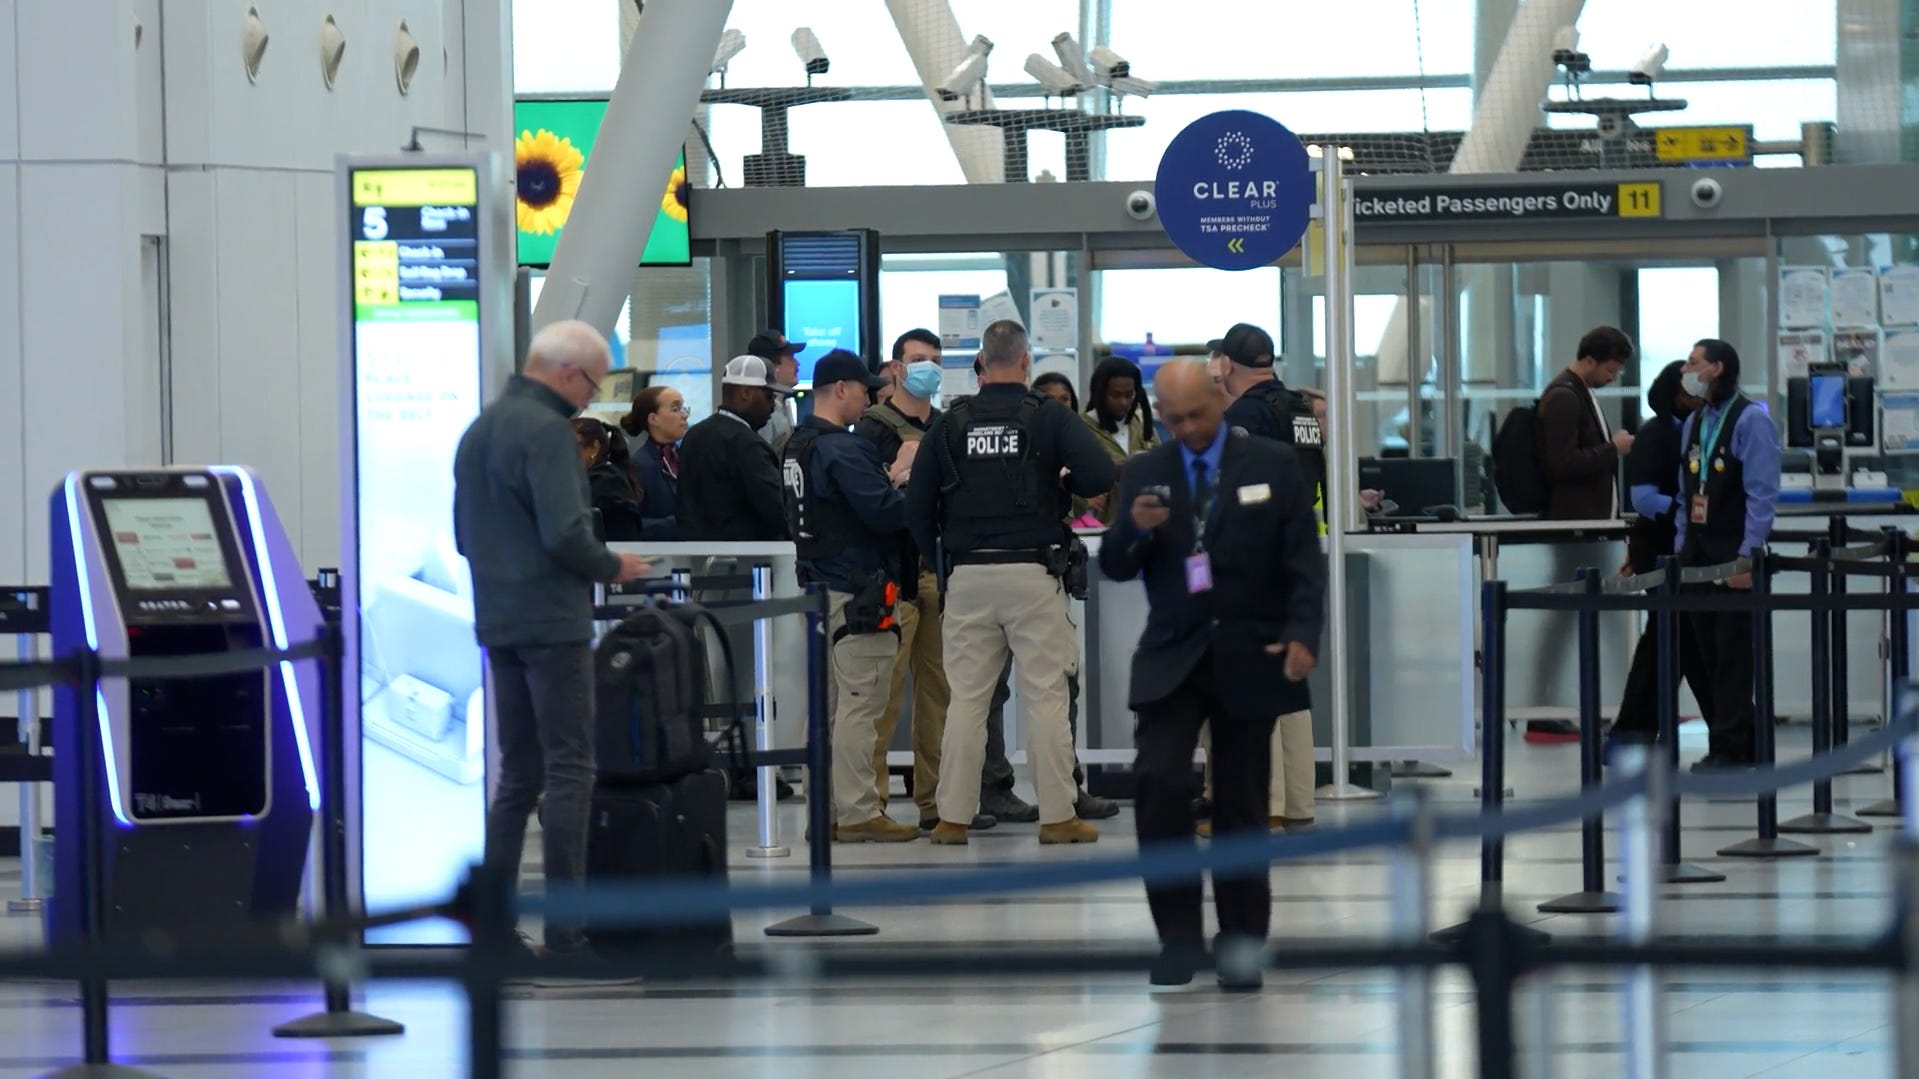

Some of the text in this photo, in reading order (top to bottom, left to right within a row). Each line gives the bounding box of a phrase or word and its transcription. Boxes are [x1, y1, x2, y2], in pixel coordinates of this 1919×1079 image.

[1193, 181, 1277, 199] CLEAR
[1250, 200, 1277, 209] PLUS
[1353, 190, 1650, 215] icketed Passengers Only 11
[363, 206, 389, 240] 5
[1237, 215, 1270, 223] WITHOUT
[1200, 224, 1218, 233] TSA
[967, 435, 1019, 455] POLICE
